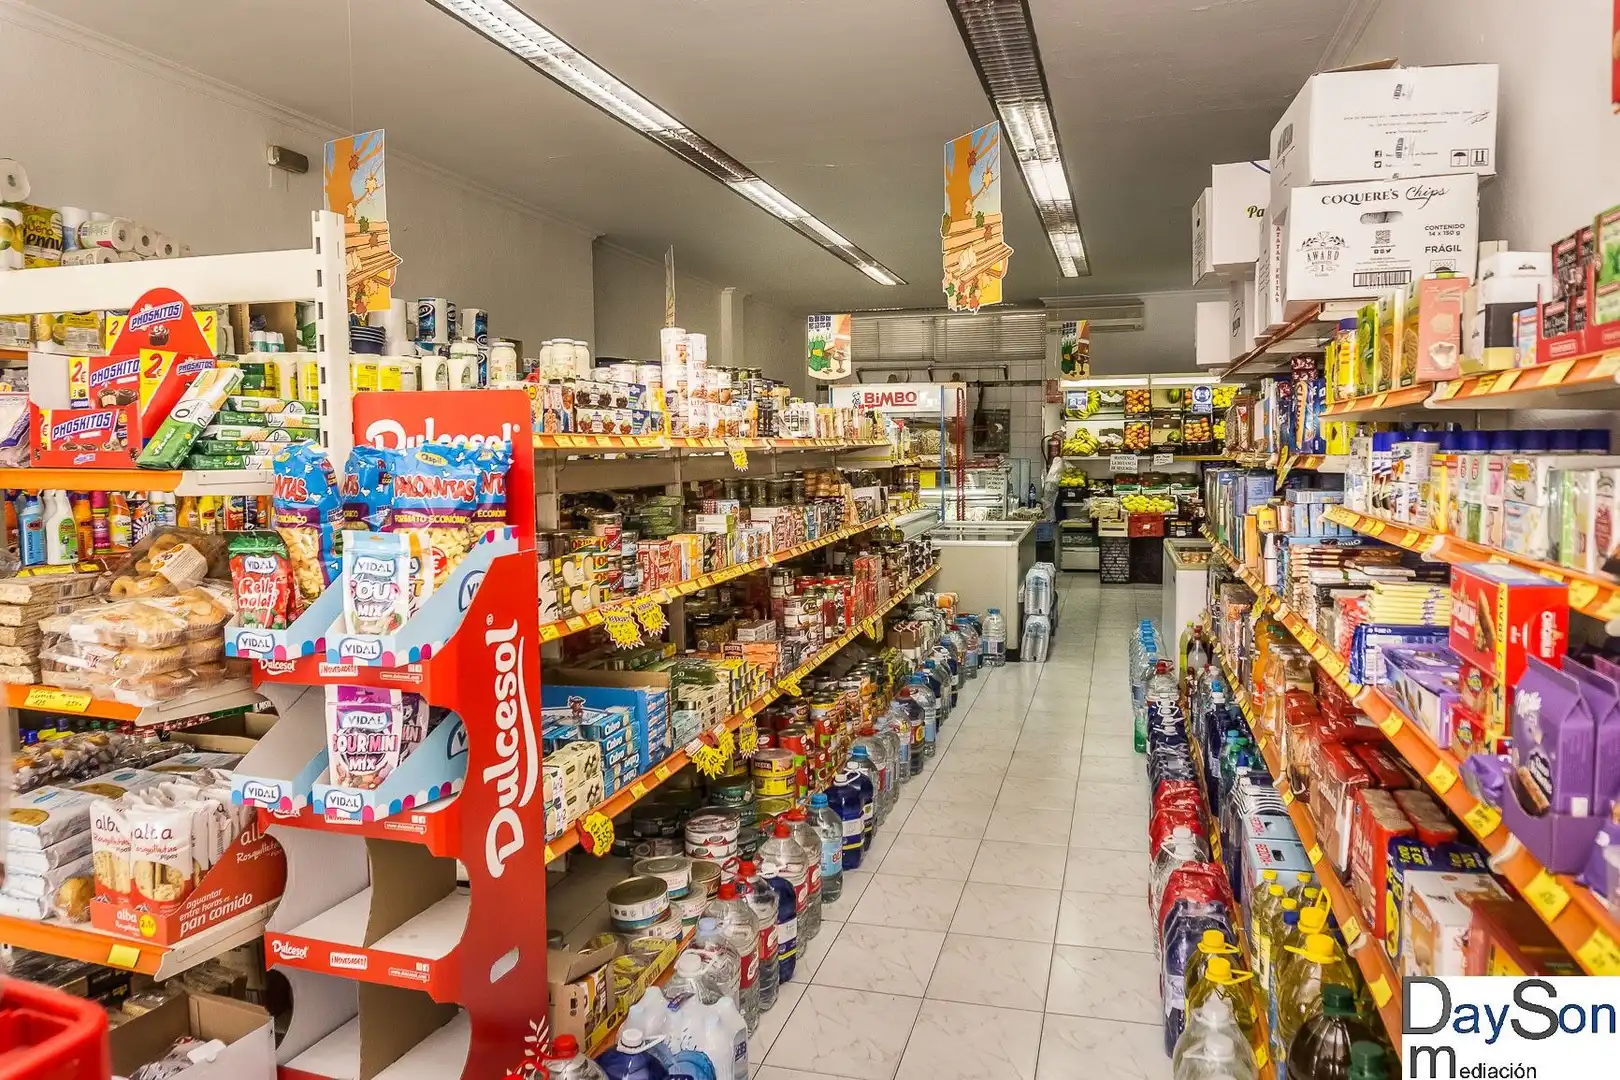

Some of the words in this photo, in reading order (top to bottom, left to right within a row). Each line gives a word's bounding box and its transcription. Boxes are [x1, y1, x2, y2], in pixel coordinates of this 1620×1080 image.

[1321, 188, 1400, 206] COQUERE'S
[1404, 185, 1451, 210] Chips
[1246, 205, 1266, 219] Pa
[1424, 223, 1466, 231] CONTENIDO
[1306, 250, 1340, 262] AWARD
[1424, 243, 1463, 254] FRÁGIL
[131, 303, 182, 329] PHOSKITOS
[91, 358, 140, 386] PHOSKITO
[178, 361, 215, 373] PHOSKITOS
[52, 412, 112, 440] PHOSKITOS
[247, 557, 274, 570] VIDAL
[357, 560, 393, 573] VIDAL
[357, 602, 383, 618] MIX
[241, 637, 270, 648] VIDAL
[345, 643, 378, 655] VIDAL
[258, 659, 297, 674] Dulcesol
[347, 715, 385, 726] VIDAL
[483, 618, 525, 879] Dulcesol
[606, 735, 623, 751] Calvo
[348, 755, 377, 772] MIX
[609, 750, 625, 765] Calvo
[247, 786, 277, 799] VIDAL
[329, 795, 360, 809] VIDAL
[186, 888, 223, 910] aguantar
[116, 909, 137, 923] alba
[179, 907, 202, 922] entre
[202, 898, 223, 911] horas
[180, 912, 207, 938] pan
[208, 892, 253, 920] comido
[271, 939, 310, 958] Dulcesol
